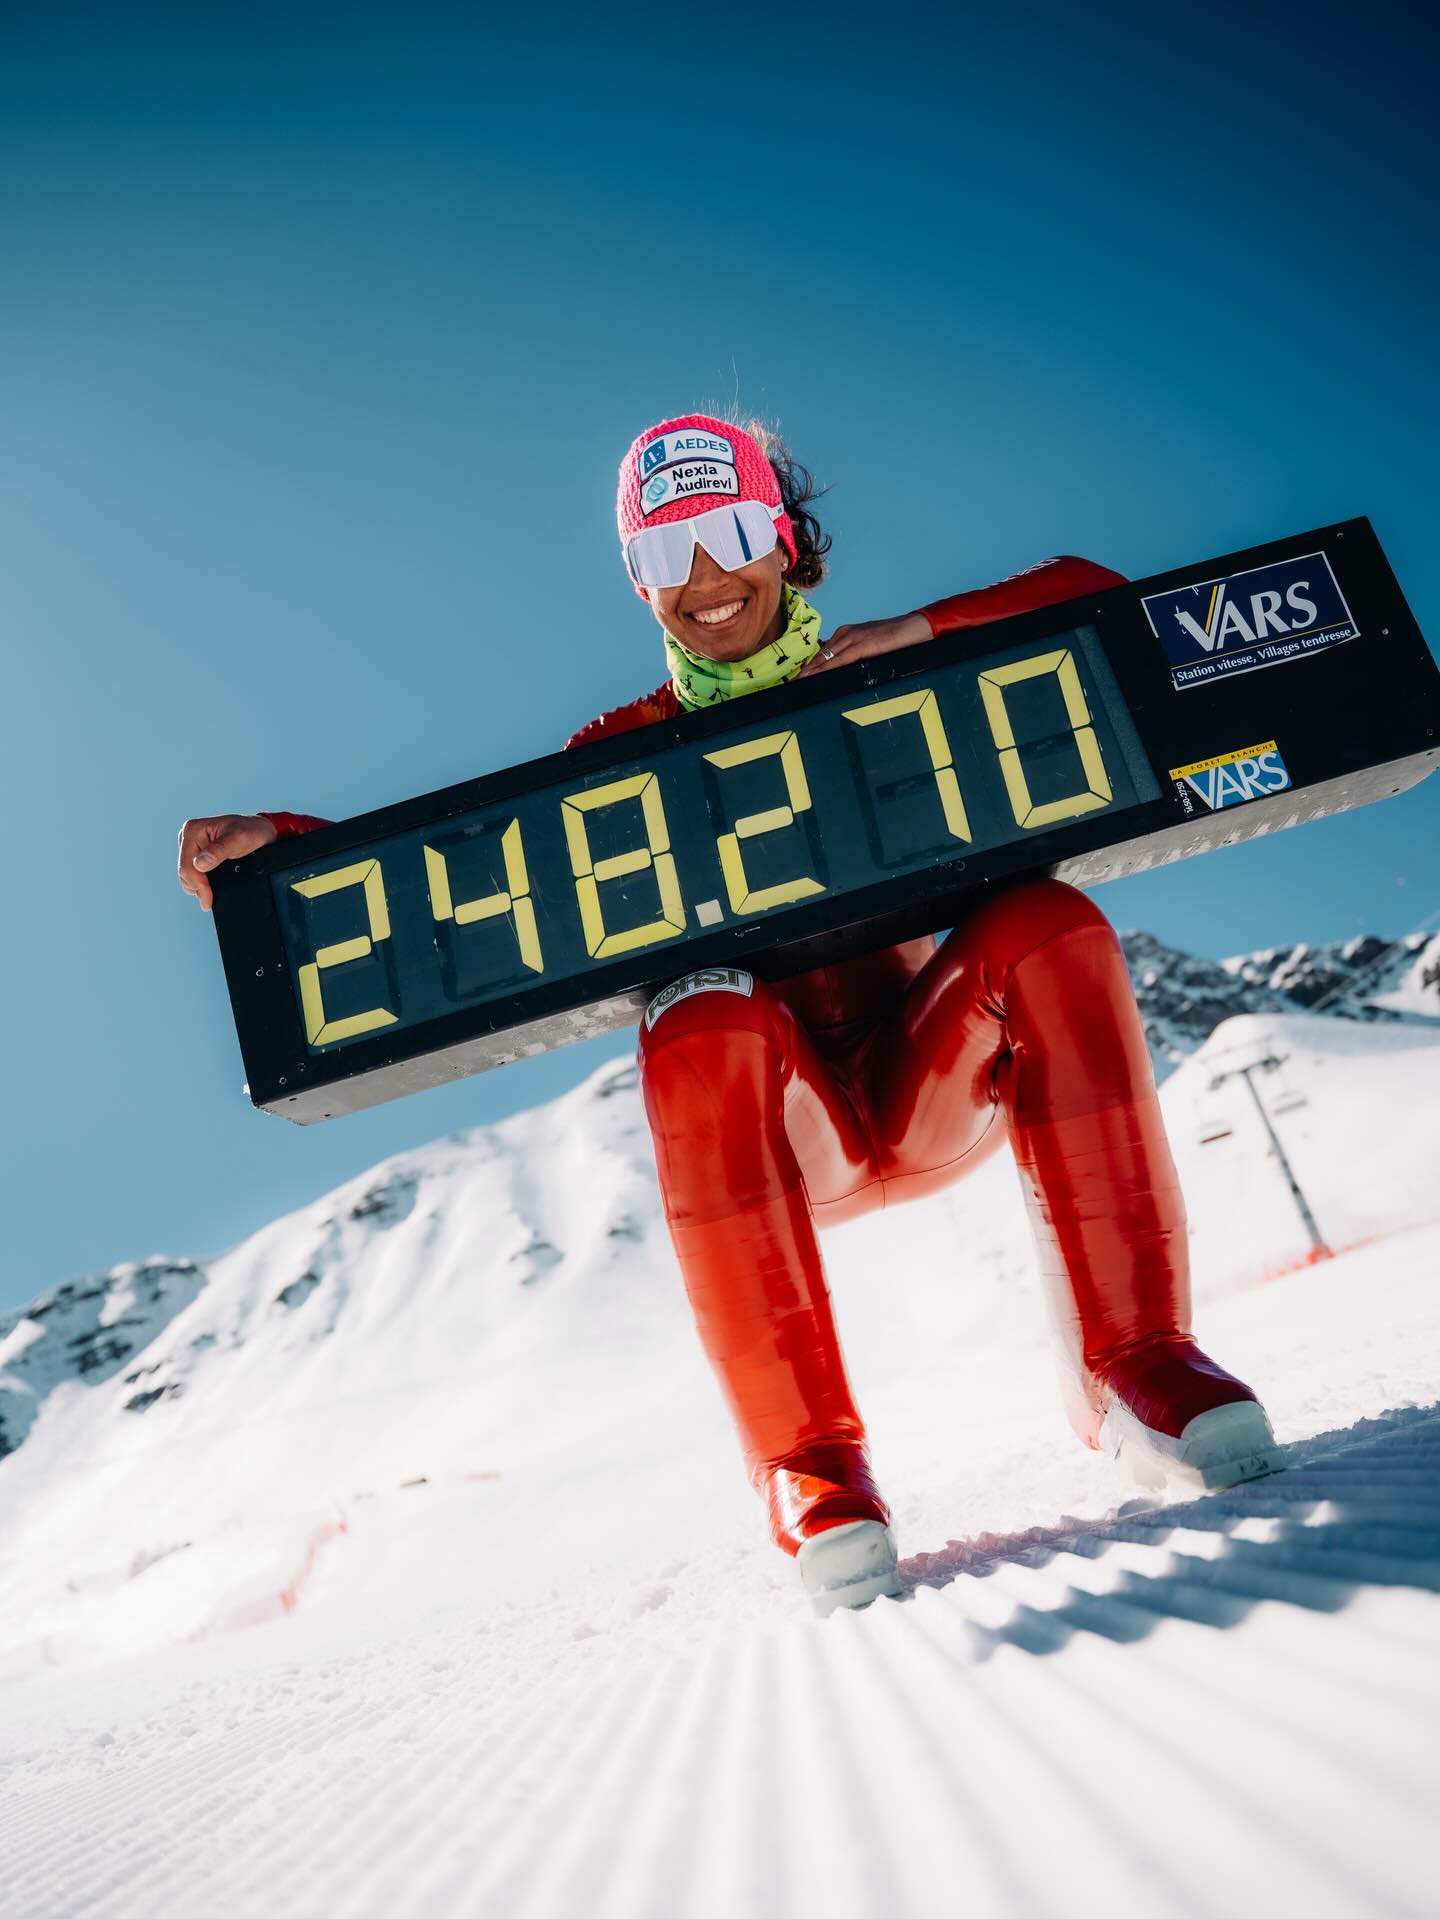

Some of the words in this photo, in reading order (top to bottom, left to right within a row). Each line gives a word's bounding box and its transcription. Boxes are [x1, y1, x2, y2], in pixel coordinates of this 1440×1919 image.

[674, 438, 729, 453] AEDES
[672, 464, 718, 481] Nexia
[675, 478, 732, 494] Audirevi
[1174, 581, 1318, 652] VARS
[1176, 665, 1216, 682] Station
[1216, 653, 1258, 670] vitesse,
[1257, 642, 1301, 660] Villages
[1301, 627, 1351, 649] tendresse
[1231, 743, 1274, 759] BLANCHE
[1182, 752, 1289, 810] VARS
[290, 648, 1113, 1050] 248.270
